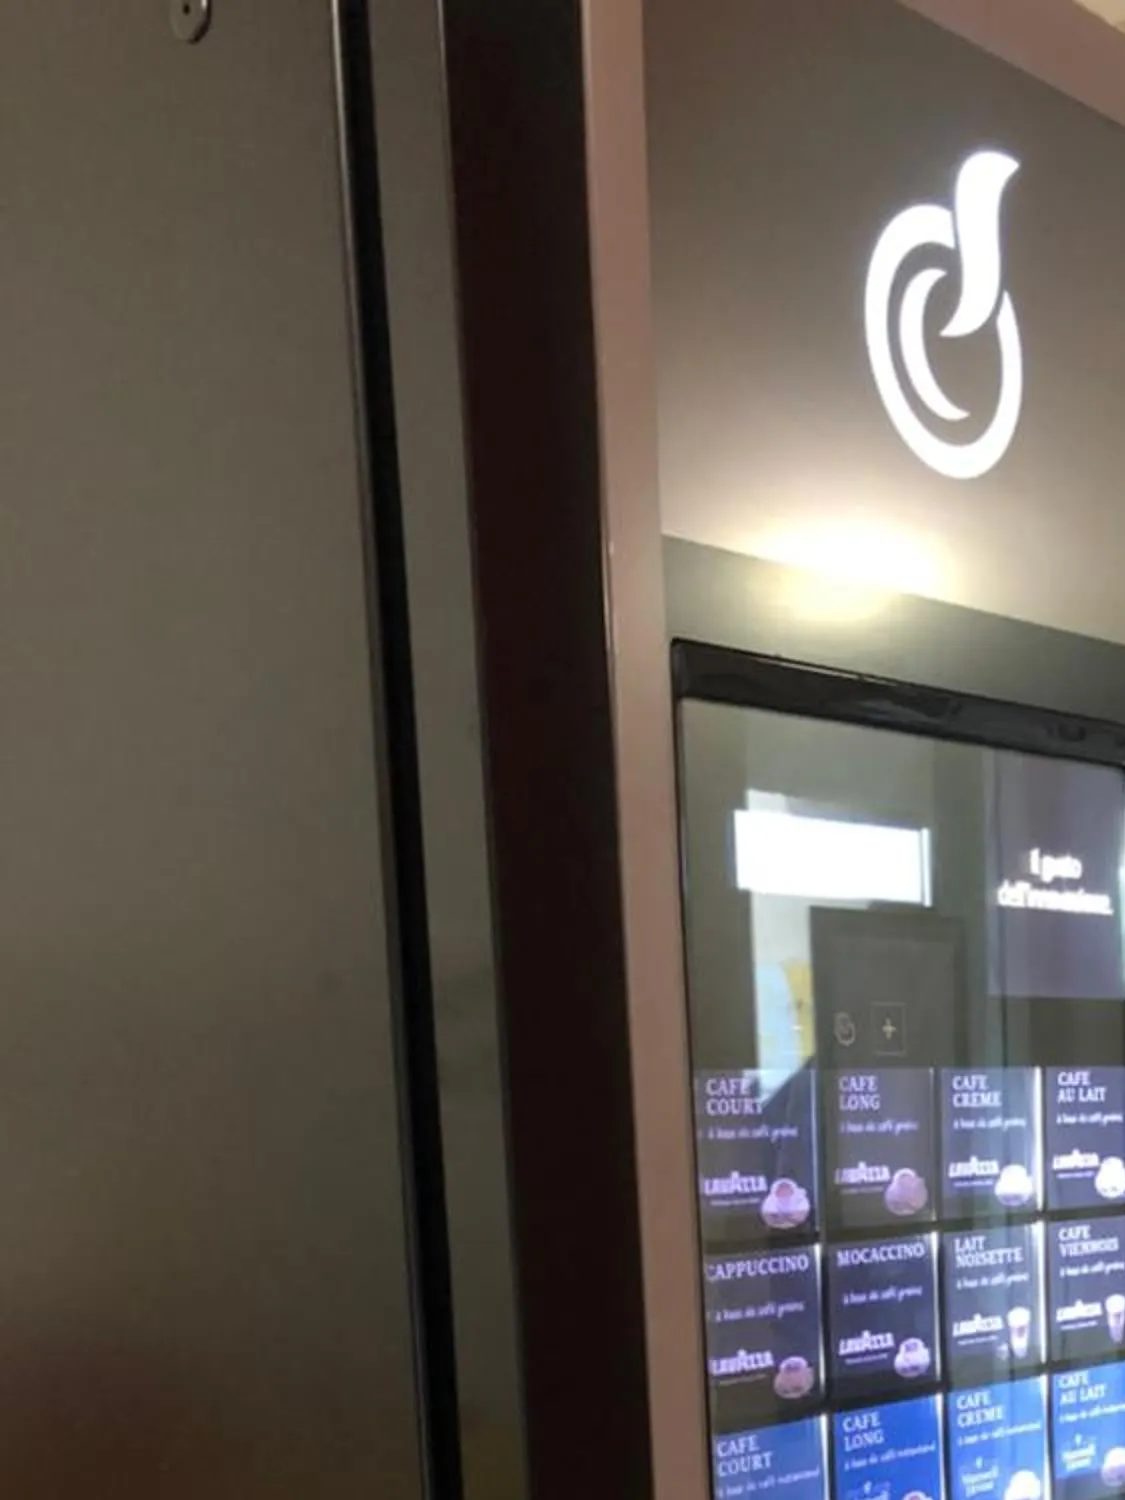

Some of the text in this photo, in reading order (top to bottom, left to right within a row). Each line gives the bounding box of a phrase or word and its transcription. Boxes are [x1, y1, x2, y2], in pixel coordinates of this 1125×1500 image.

[839, 1075, 878, 1092] CAFE
[1079, 1086, 1107, 1103] LAIT
[839, 1093, 881, 1110] LONG
[836, 1241, 926, 1268] MOCACCINO
[954, 1235, 986, 1254] LAIT
[704, 1253, 809, 1283] CAPPUCCINO
[717, 1434, 760, 1457] CAFE
[844, 1428, 885, 1453] LONG
[717, 1451, 774, 1477] COURT
